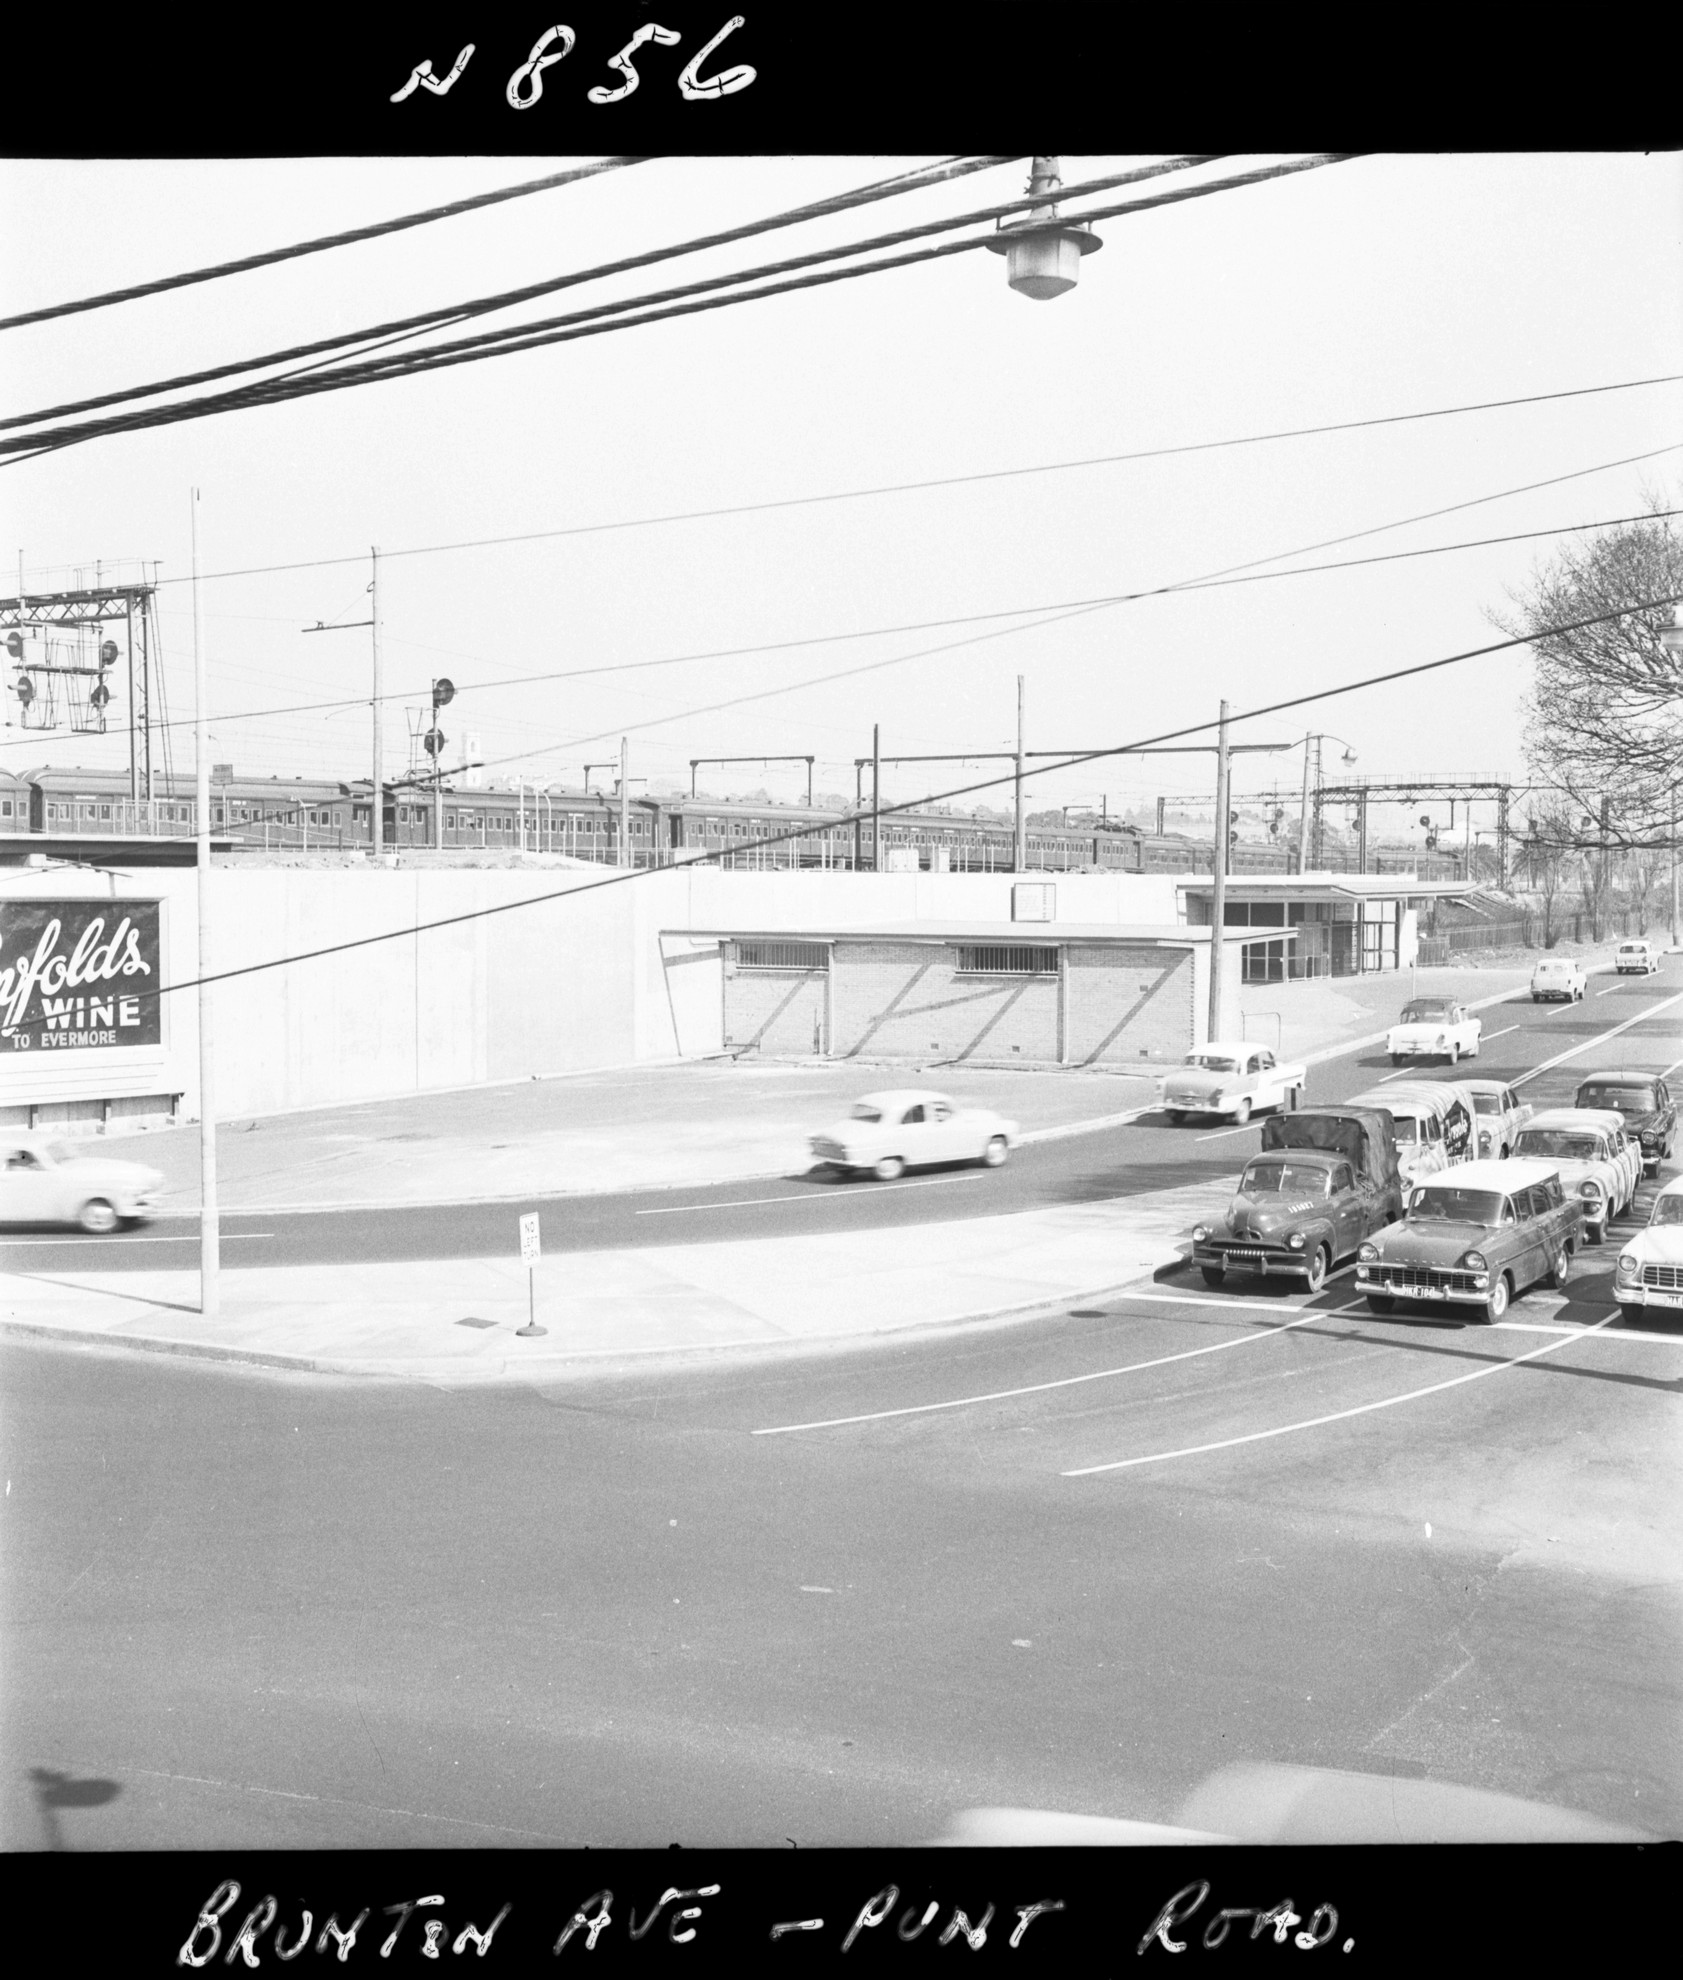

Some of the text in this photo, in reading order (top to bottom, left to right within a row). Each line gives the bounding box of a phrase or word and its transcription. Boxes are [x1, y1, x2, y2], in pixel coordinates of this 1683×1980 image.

[41, 995, 140, 1029] WINE
[12, 1030, 116, 1048] TO EVERMORE
[524, 1221, 535, 1234] NO
